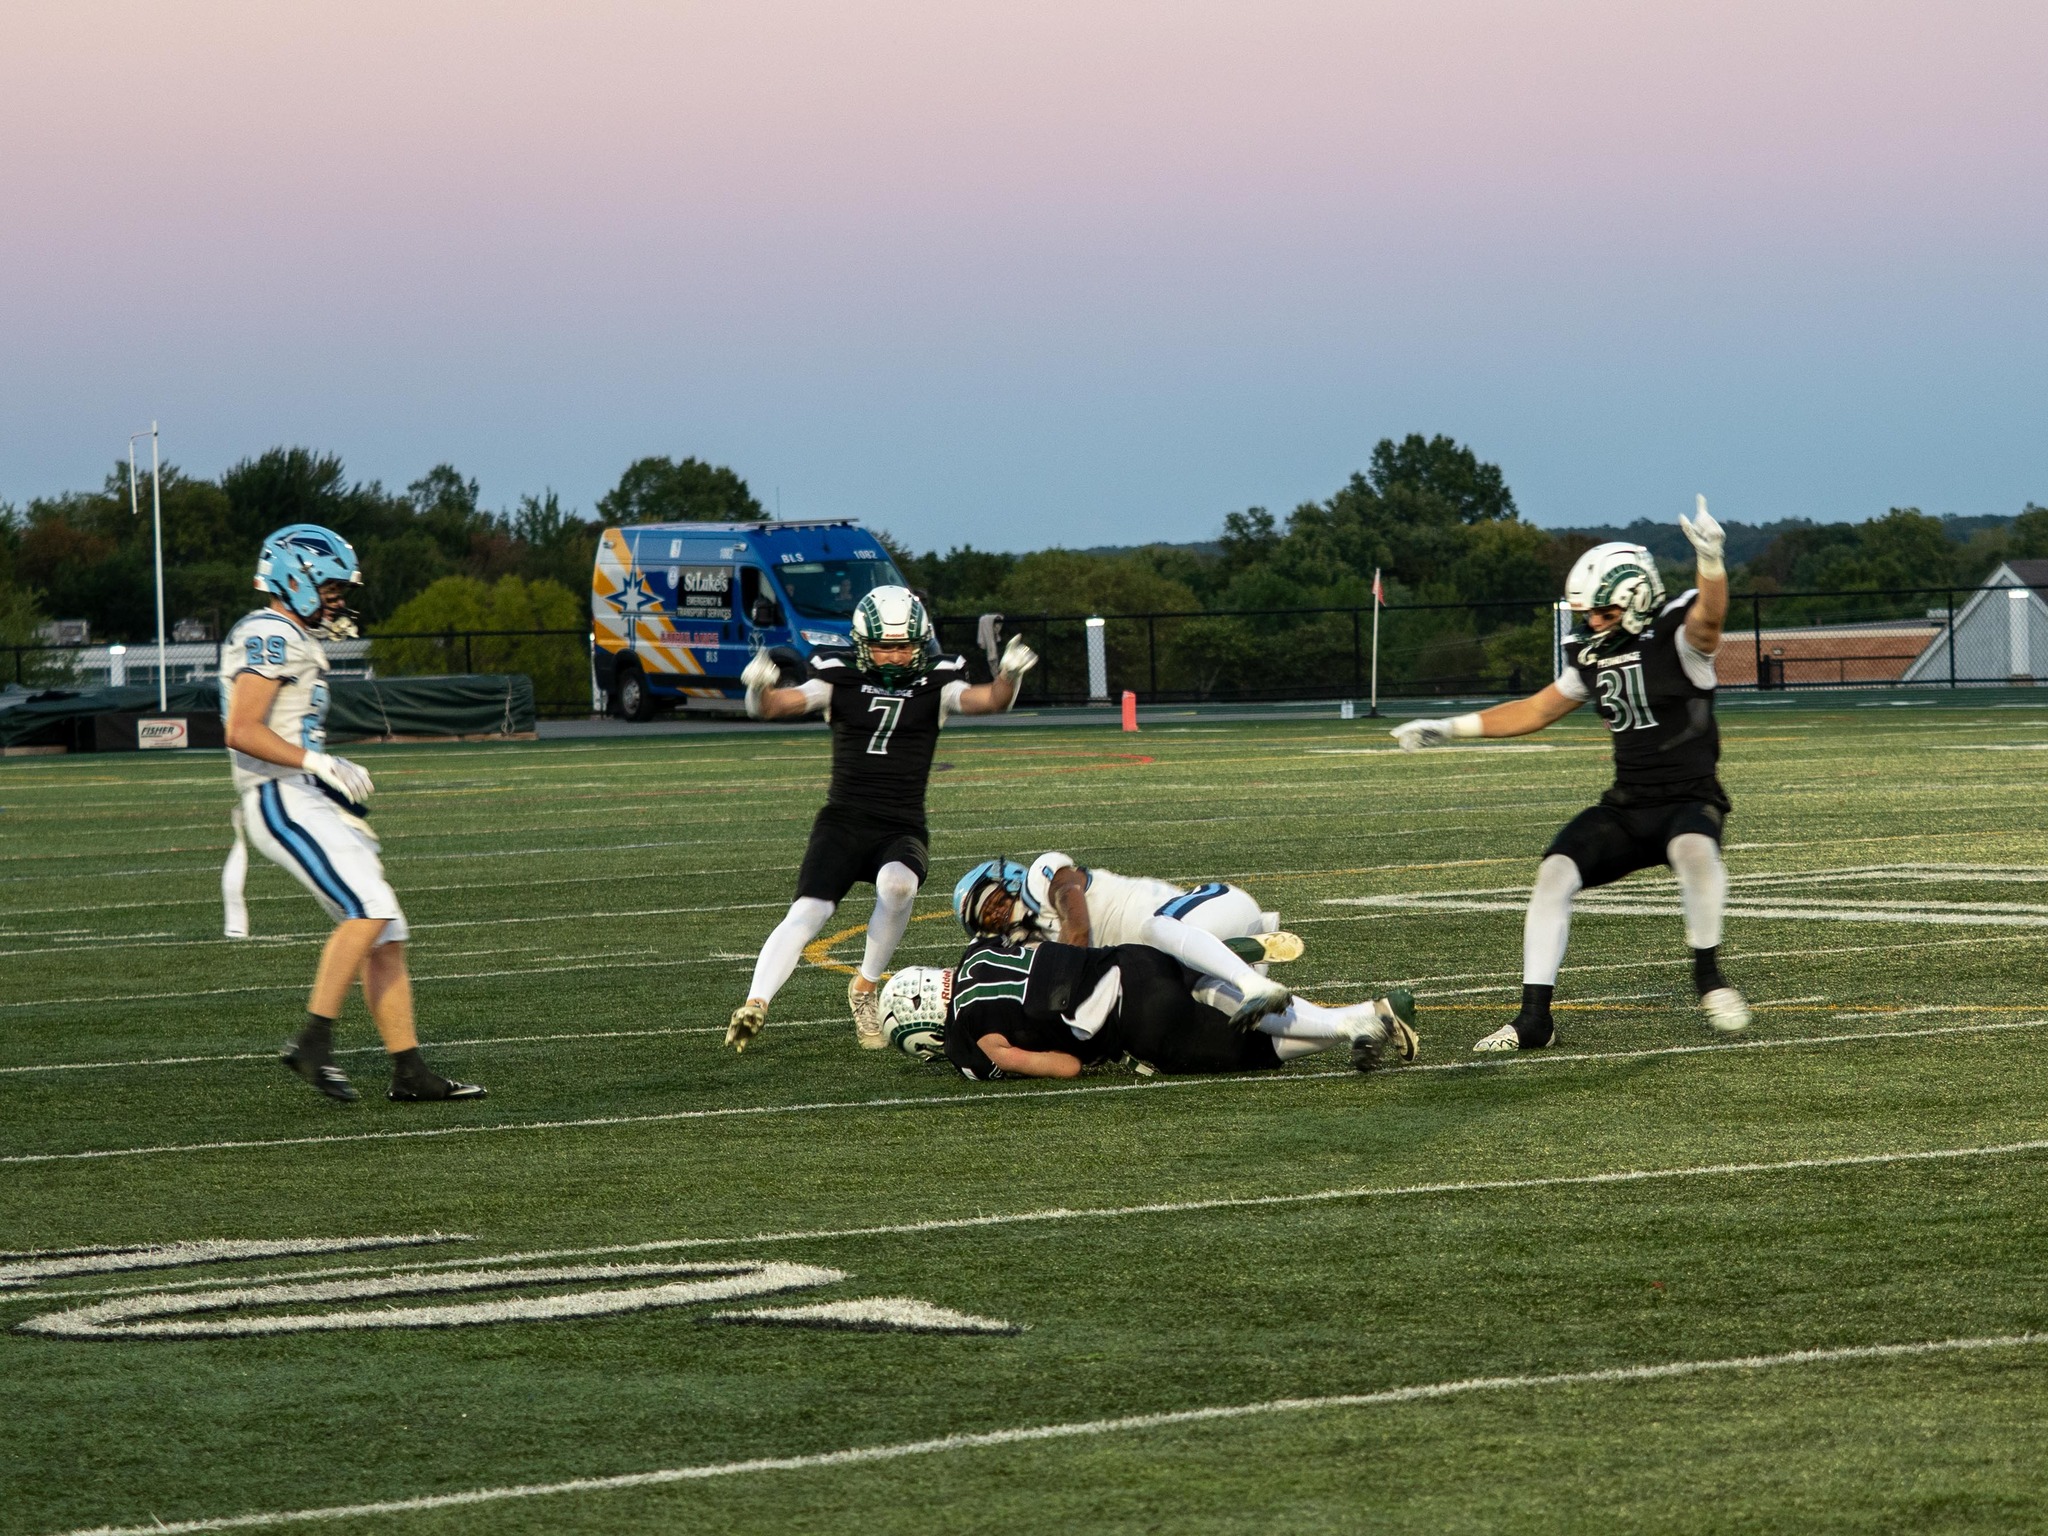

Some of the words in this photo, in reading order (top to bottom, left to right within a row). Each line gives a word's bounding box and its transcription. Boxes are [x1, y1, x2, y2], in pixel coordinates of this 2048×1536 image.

[781, 553, 804, 563] BLS
[853, 550, 878, 560] 1082
[686, 596, 717, 606] EMERGENCY
[676, 607, 706, 617] TRANSPORT
[707, 608, 732, 619] SERVICES
[660, 632, 719, 647] AMBULANCE
[245, 636, 286, 665] 29
[1596, 664, 1659, 732] 31
[141, 726, 175, 736] FISHER
[867, 697, 905, 754] 7
[954, 946, 1037, 1020] 12
